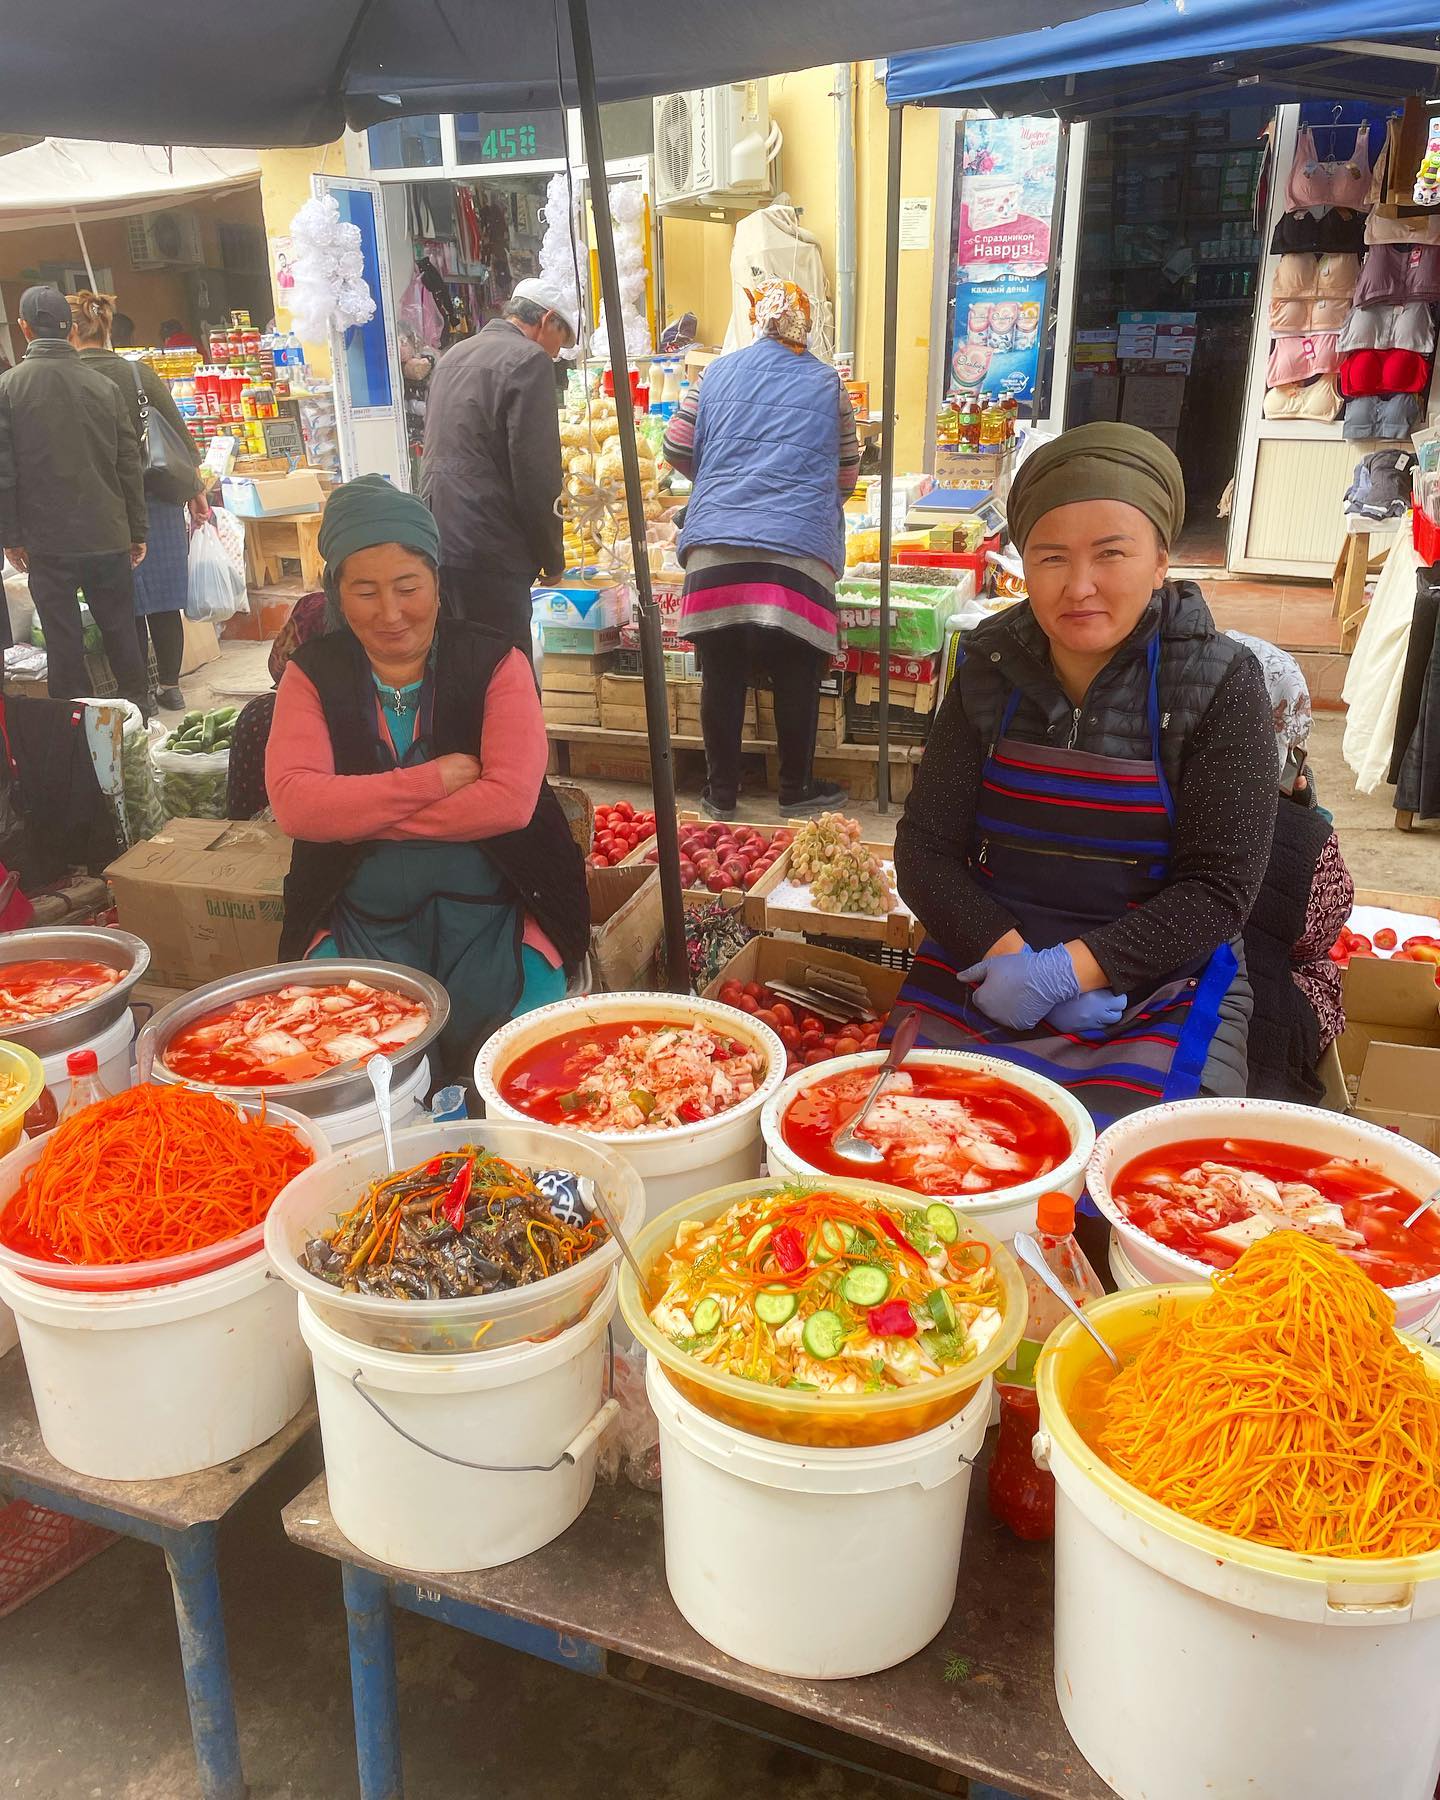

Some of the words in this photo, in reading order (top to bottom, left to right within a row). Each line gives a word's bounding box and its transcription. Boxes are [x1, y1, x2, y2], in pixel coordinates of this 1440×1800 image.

[482, 125, 536, 159] 458
[974, 234, 982, 243] С
[984, 234, 1035, 245] праздником
[974, 242, 1034, 258] Навруз!
[971, 285, 1005, 294] каждый
[1006, 285, 1030, 294] день!
[206, 899, 256, 920] РУСАГРО
